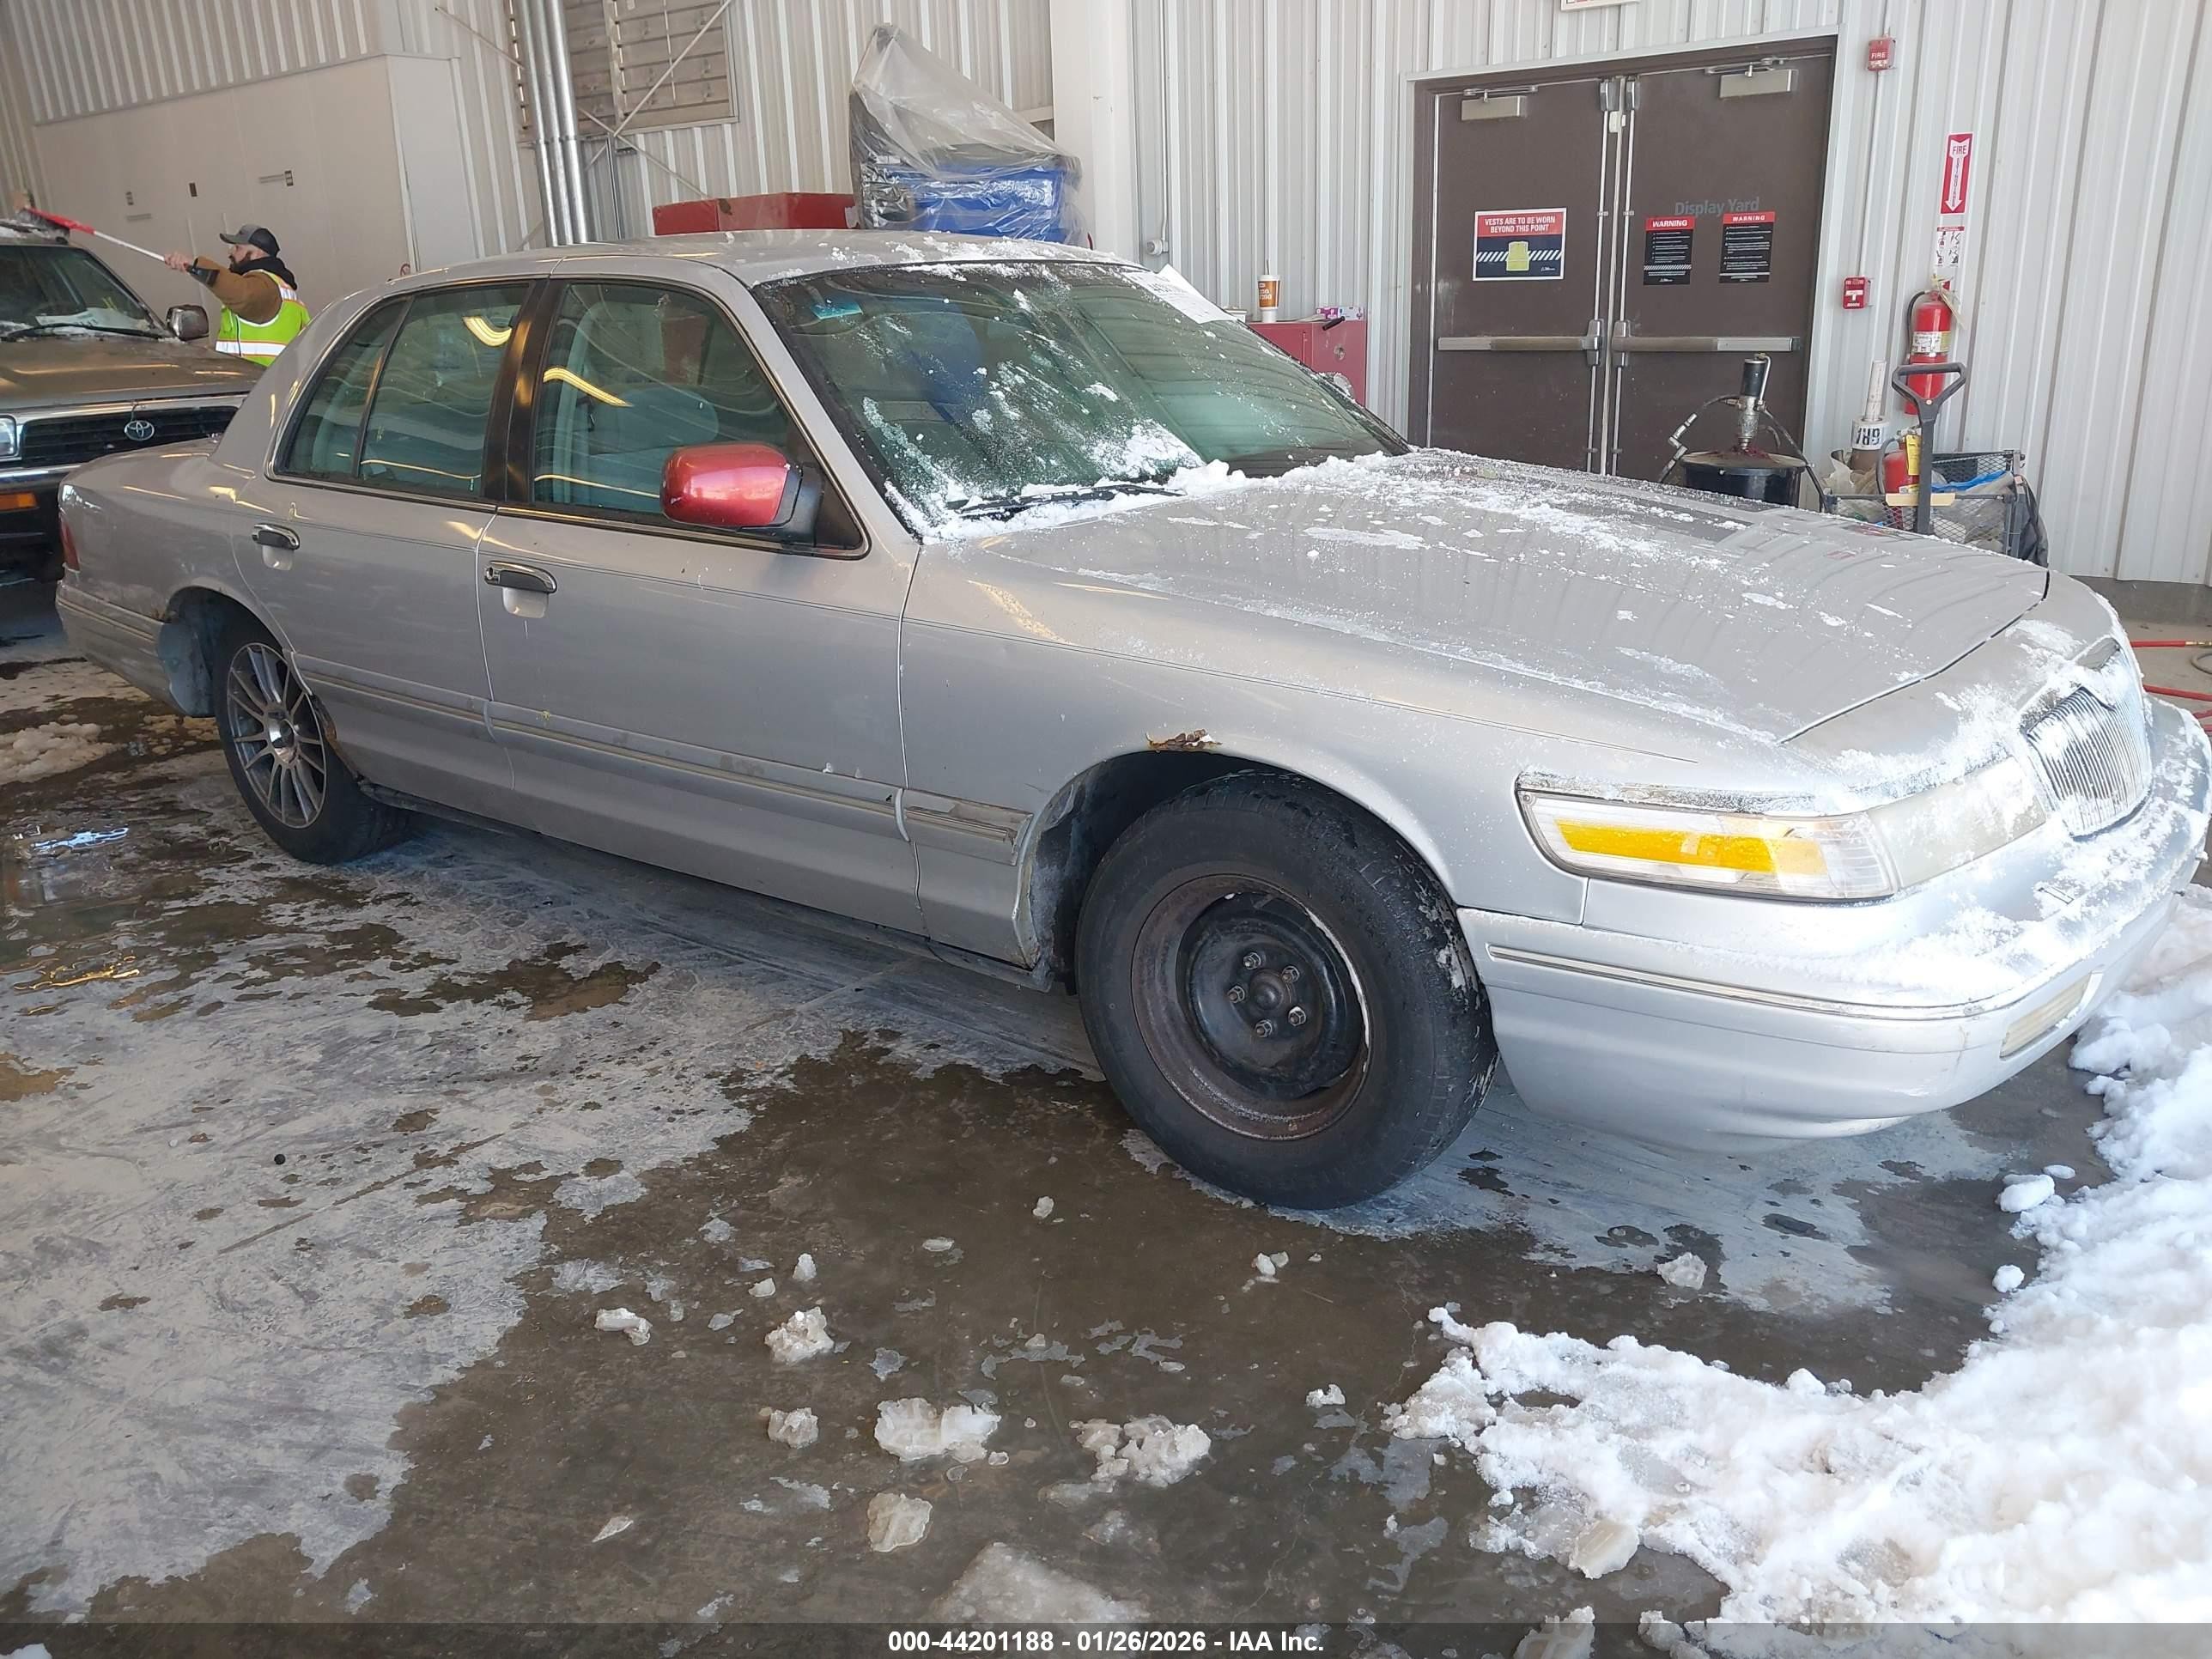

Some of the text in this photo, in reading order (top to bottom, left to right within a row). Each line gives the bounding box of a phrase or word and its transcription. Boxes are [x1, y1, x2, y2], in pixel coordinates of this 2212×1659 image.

[1952, 145, 1967, 155] FIRE
[1675, 197, 1759, 218] Display Yard
[1652, 219, 1688, 228] WARNING
[1490, 225, 1515, 234] BEYOND
